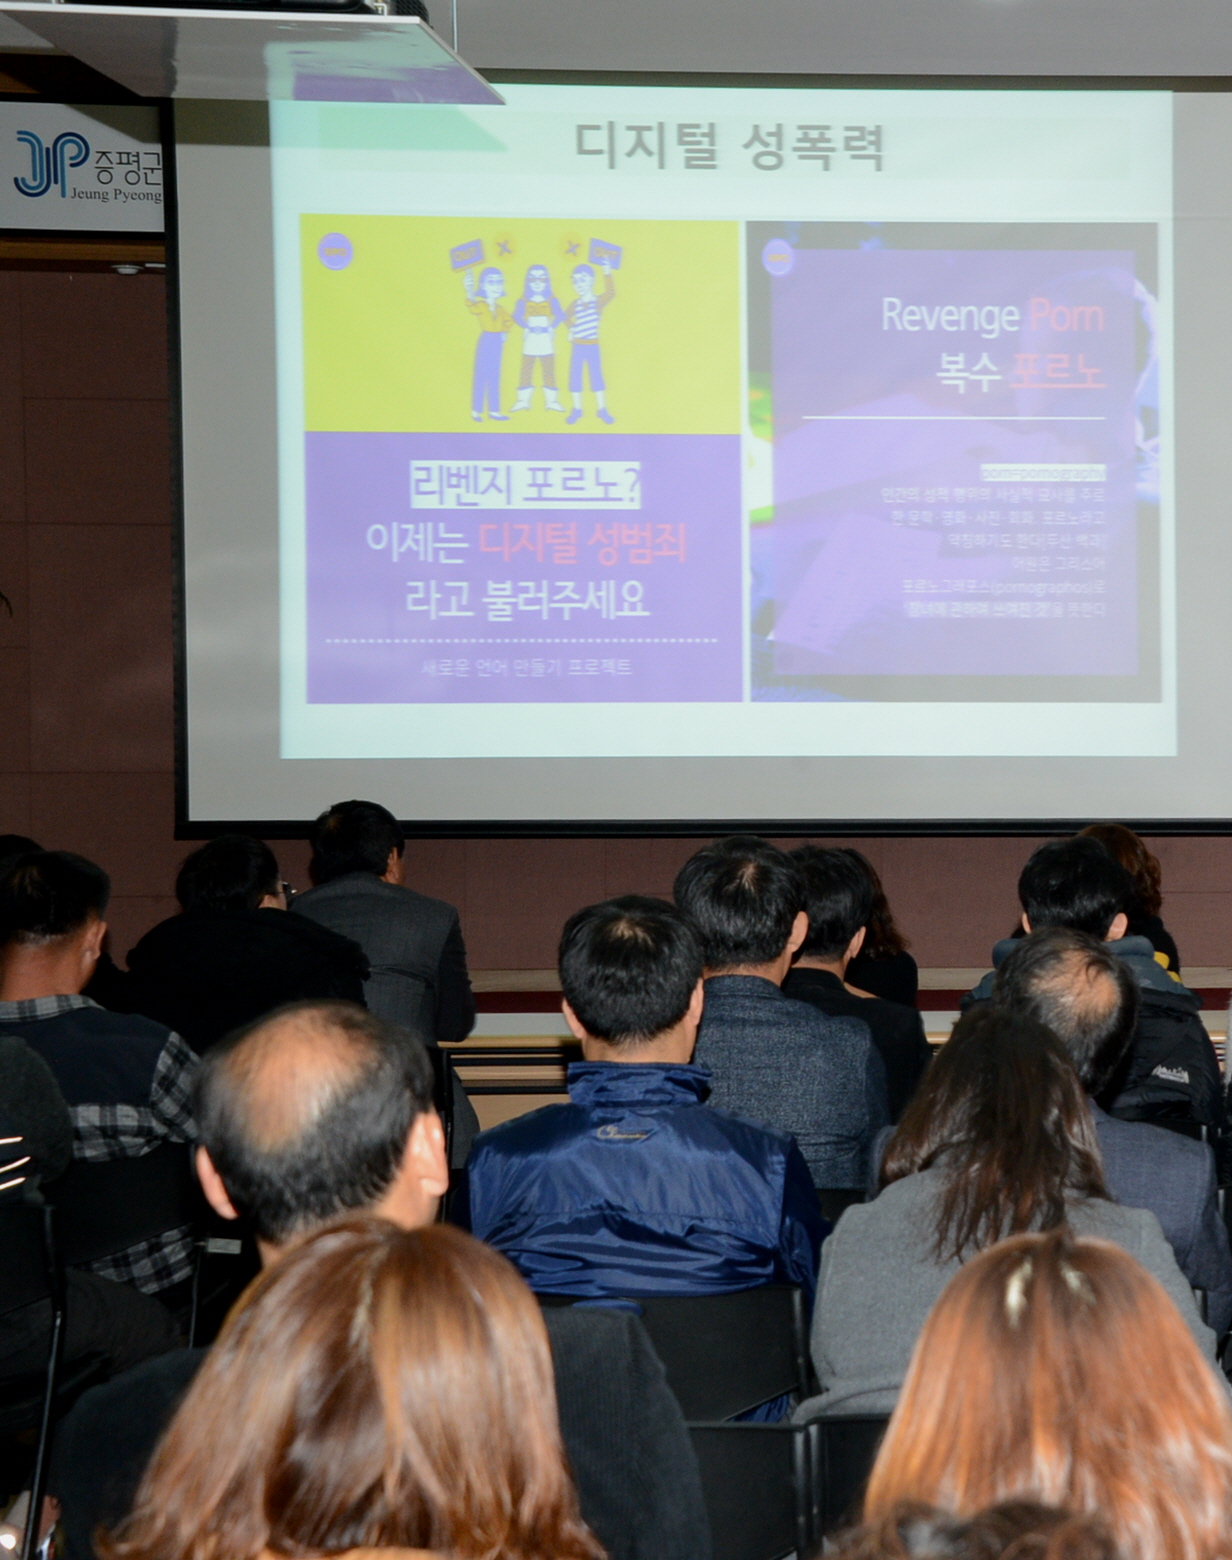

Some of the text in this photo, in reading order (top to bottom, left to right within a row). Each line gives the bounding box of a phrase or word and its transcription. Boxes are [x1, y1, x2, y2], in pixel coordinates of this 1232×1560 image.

[575, 120, 884, 172] 디지털 성폭력
[94, 150, 163, 186] 증평군
[71, 187, 163, 204] Jeung Pyeong
[882, 297, 1105, 339] Revenge Porn
[936, 352, 1107, 394] 복수 포르노
[413, 464, 640, 507] 리벤지 포르노?
[366, 521, 687, 566] 이제는 디지털 성범죄
[406, 580, 652, 621] 라고 불러주세요
[421, 657, 634, 677] 새로운 언어 만들기 프로젝트
